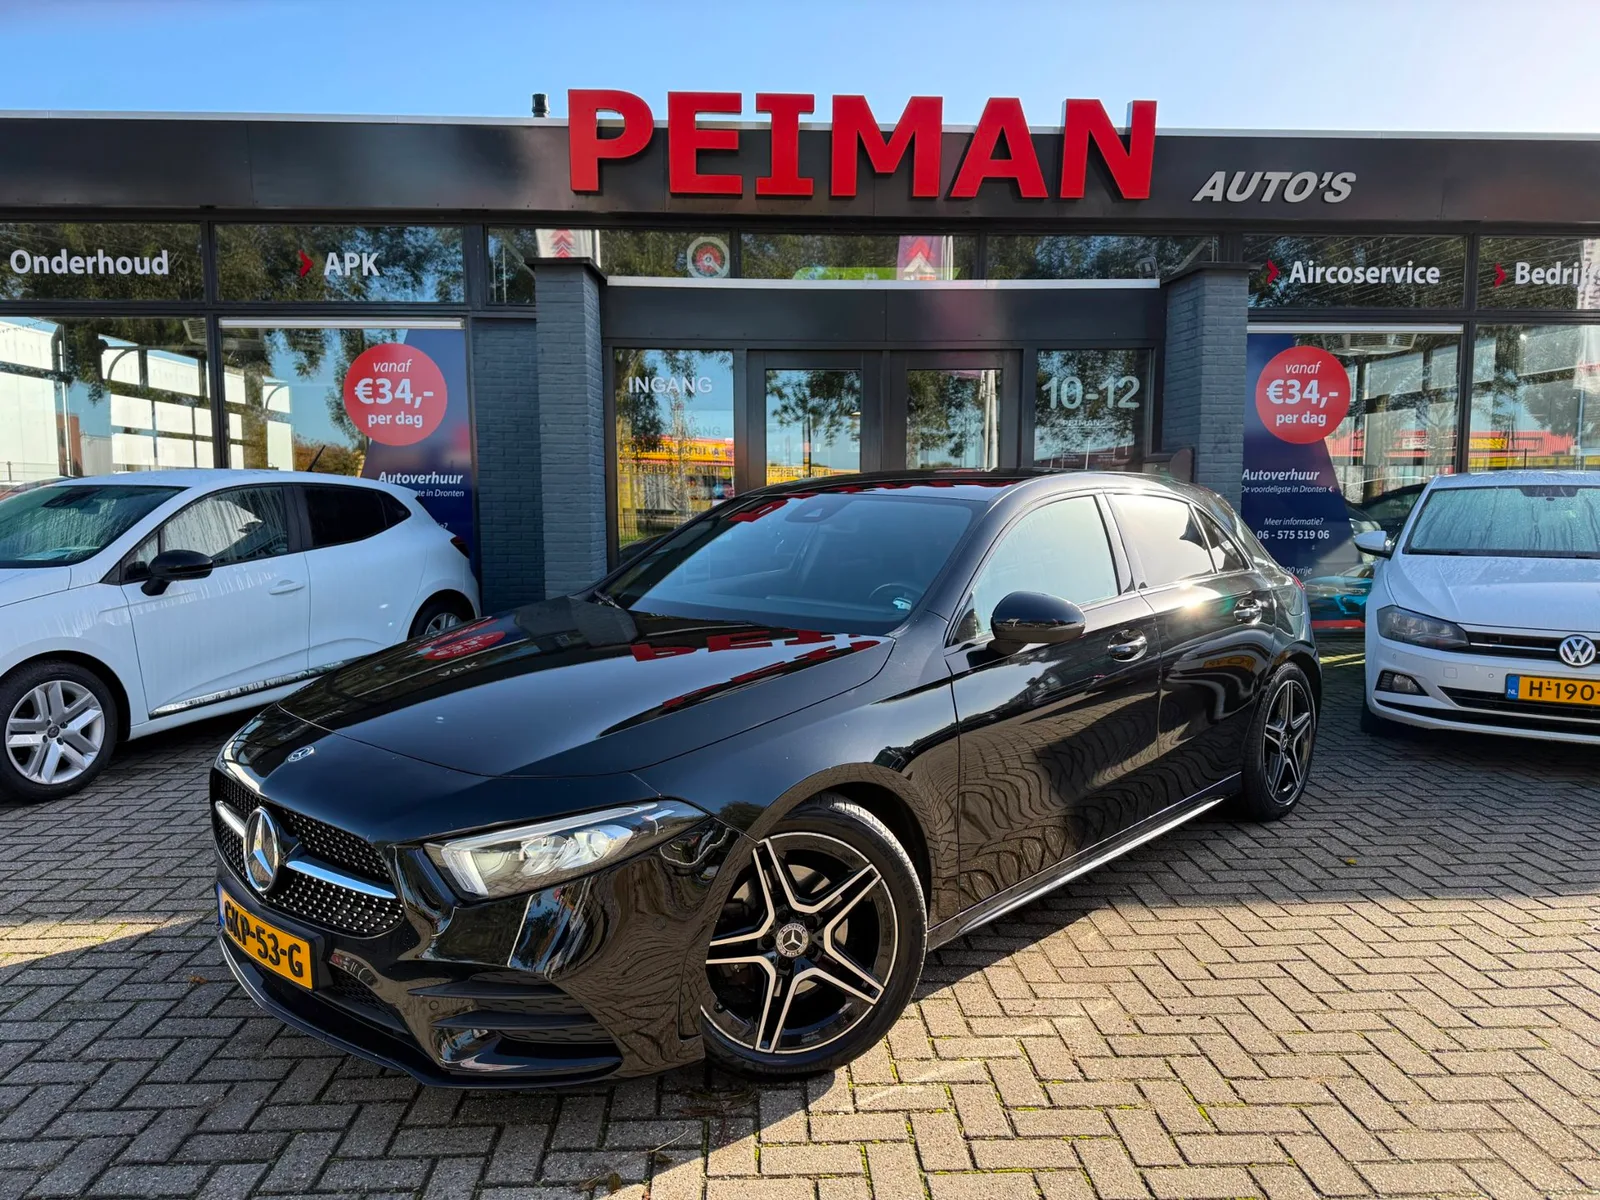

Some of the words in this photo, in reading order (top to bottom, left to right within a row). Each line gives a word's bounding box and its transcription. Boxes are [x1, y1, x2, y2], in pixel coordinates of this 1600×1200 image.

[567, 88, 1158, 200] PEIMAN
[1192, 171, 1357, 204] AUTO'S
[10, 248, 170, 276] Onderhoud
[324, 251, 381, 277] APK
[1289, 260, 1440, 284] Aircoservice
[373, 359, 412, 373] vanaf
[1285, 361, 1322, 374] vanaf
[354, 377, 434, 409] €34,-
[628, 376, 713, 393] INGANG
[1041, 375, 1141, 410] 10-12
[1266, 379, 1339, 409] €34,-
[368, 414, 392, 427] per
[395, 411, 423, 428] dag
[1276, 414, 1299, 427] per
[1301, 411, 1327, 427] dag
[378, 471, 464, 485] Autoverhuur
[1242, 468, 1321, 481] Autoverhuur
[426, 489, 434, 497] in
[434, 489, 465, 498] Dronten
[1250, 485, 1291, 494] voordeligste
[1264, 518, 1282, 526] Meer
[1282, 517, 1324, 526] informatie?
[1257, 530, 1269, 540] 06
[1277, 530, 1295, 540] 575
[1297, 530, 1316, 540] 519
[1317, 530, 1330, 540] 06
[1296, 566, 1313, 577] vrije
[224, 899, 304, 978] GKP-53-G
